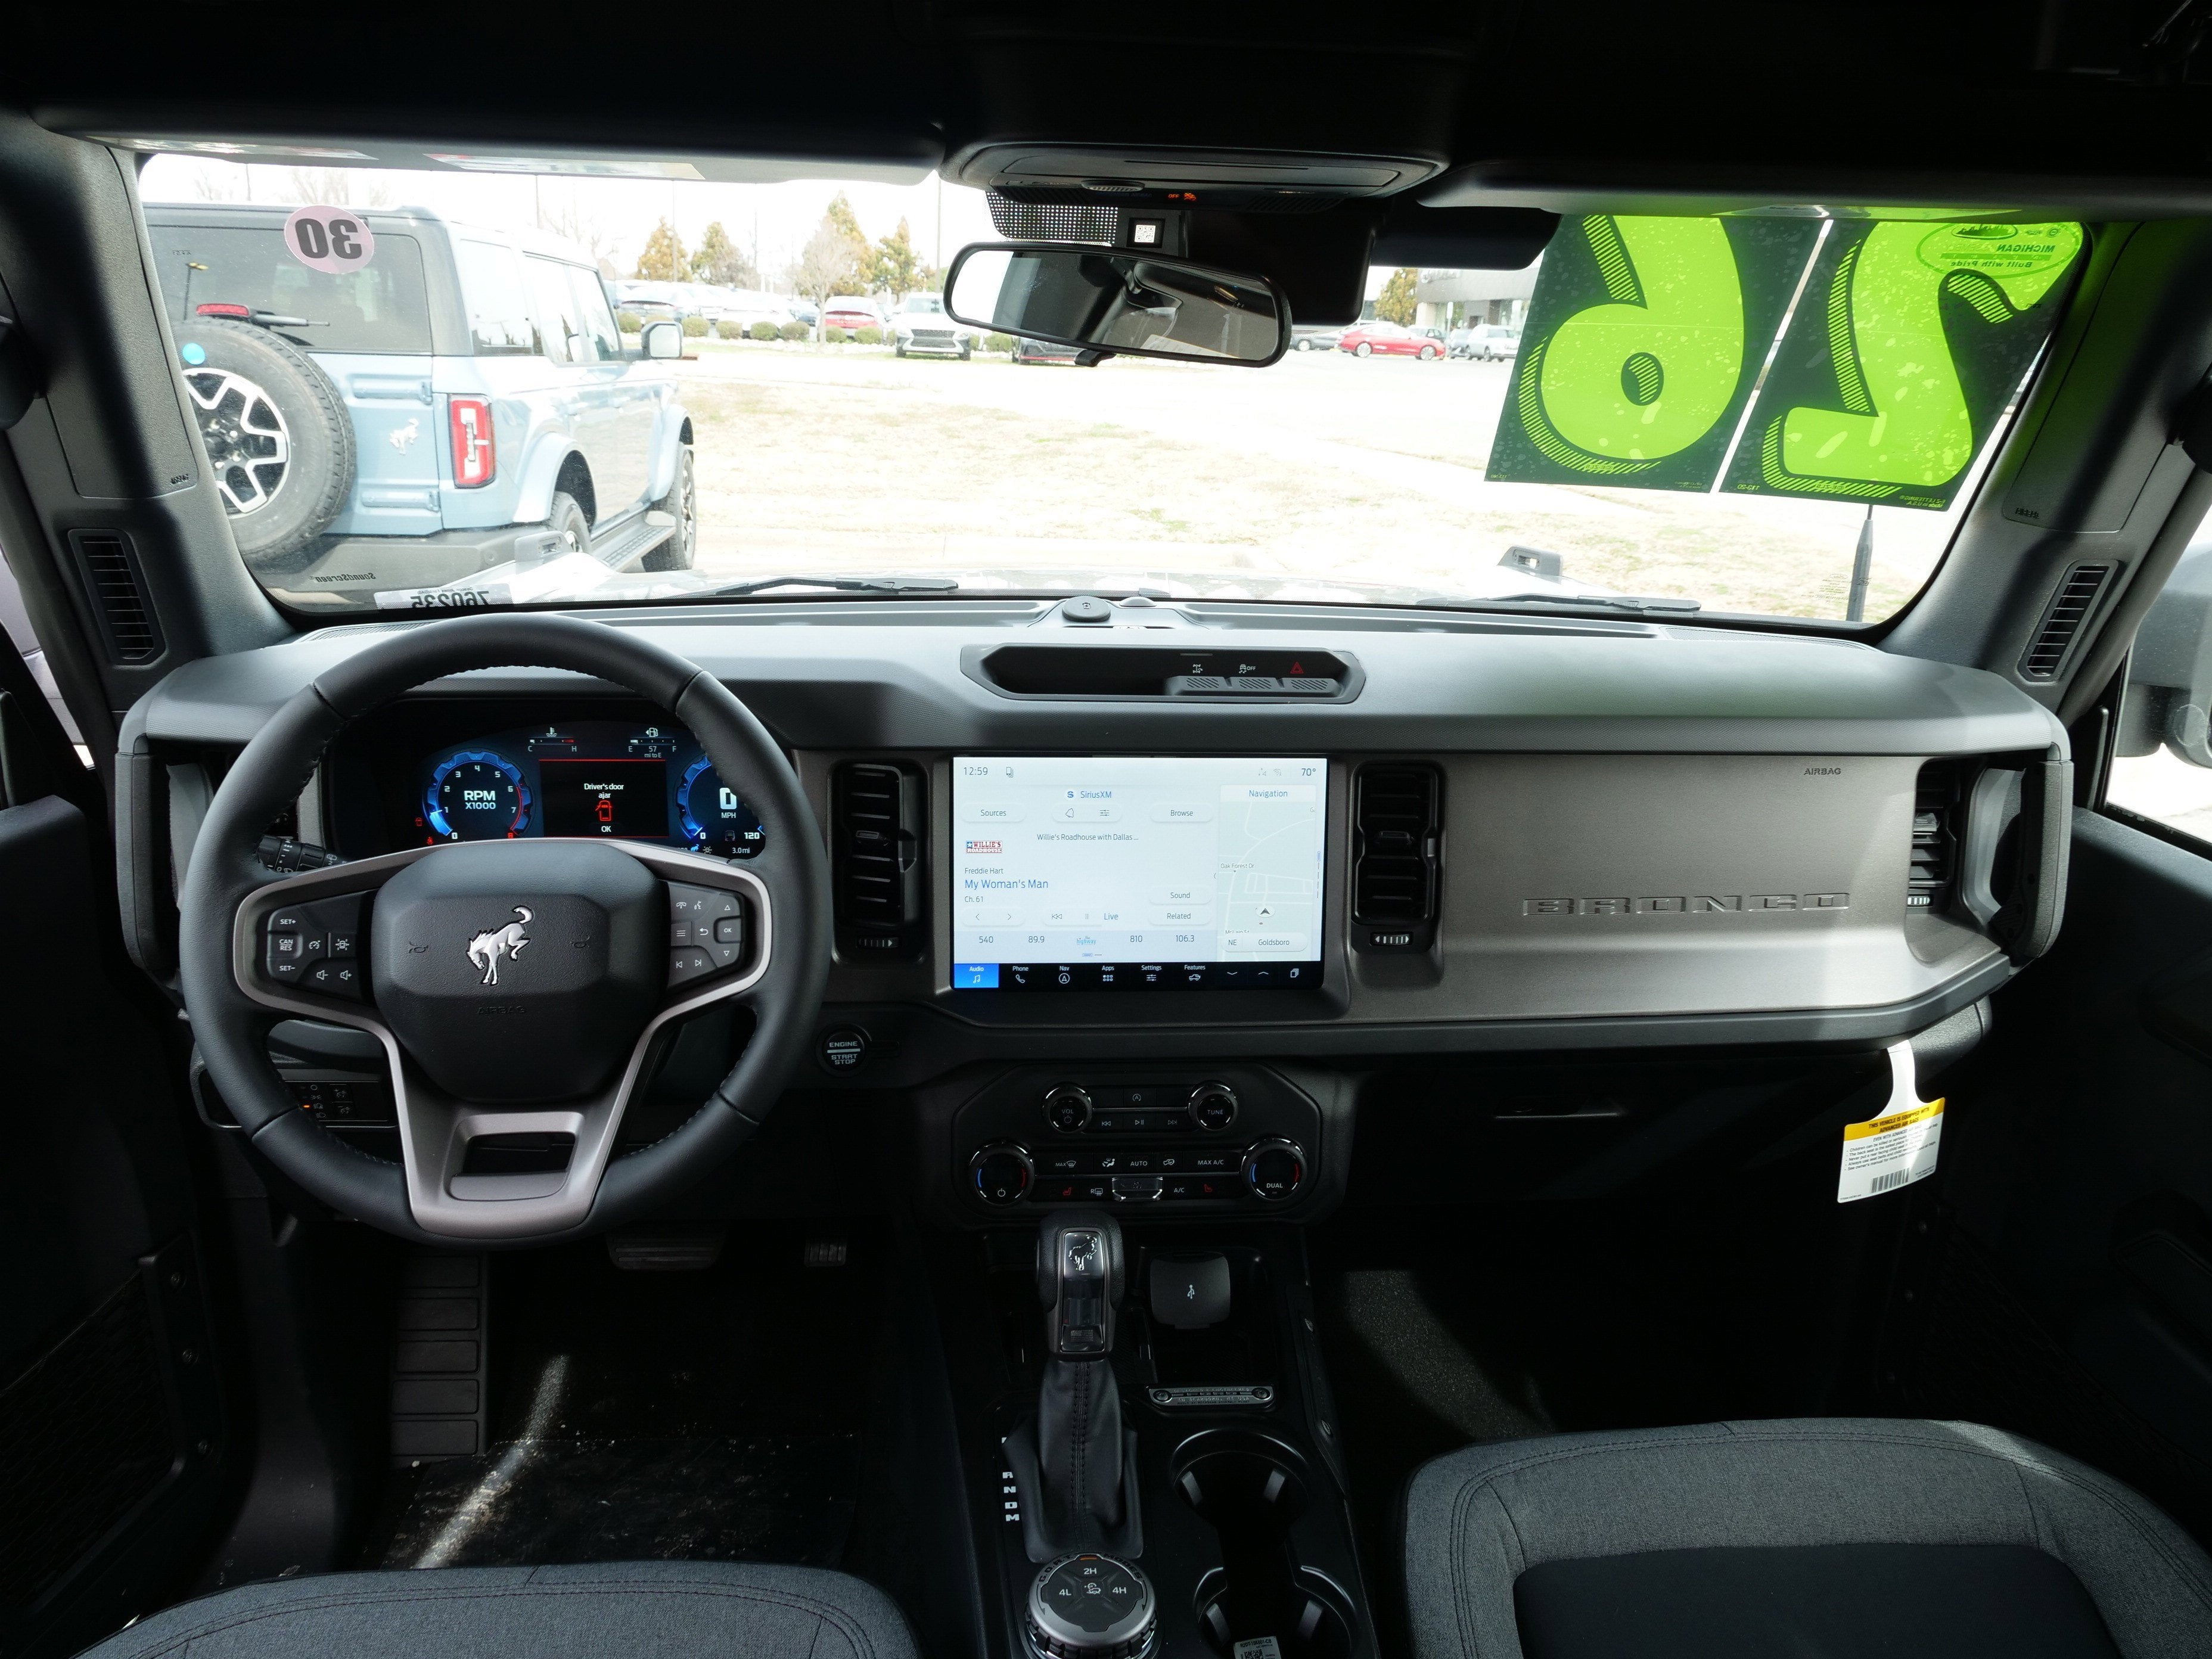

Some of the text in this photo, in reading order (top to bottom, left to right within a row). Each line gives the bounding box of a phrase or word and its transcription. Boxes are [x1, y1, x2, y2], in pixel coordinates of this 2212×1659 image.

[963, 767, 988, 775] 12:59
[464, 790, 496, 801] RPM
[1249, 790, 1288, 799] Navigation
[965, 880, 1049, 890] My Woman's Man
[1523, 893, 1848, 916] BRONCO
[477, 1006, 526, 1014] AIRBAG
[1879, 1117, 1896, 1126] VEHICLE
[1879, 1123, 1901, 1133] ADVANCED
[1104, 1553, 1143, 1579] MODES
